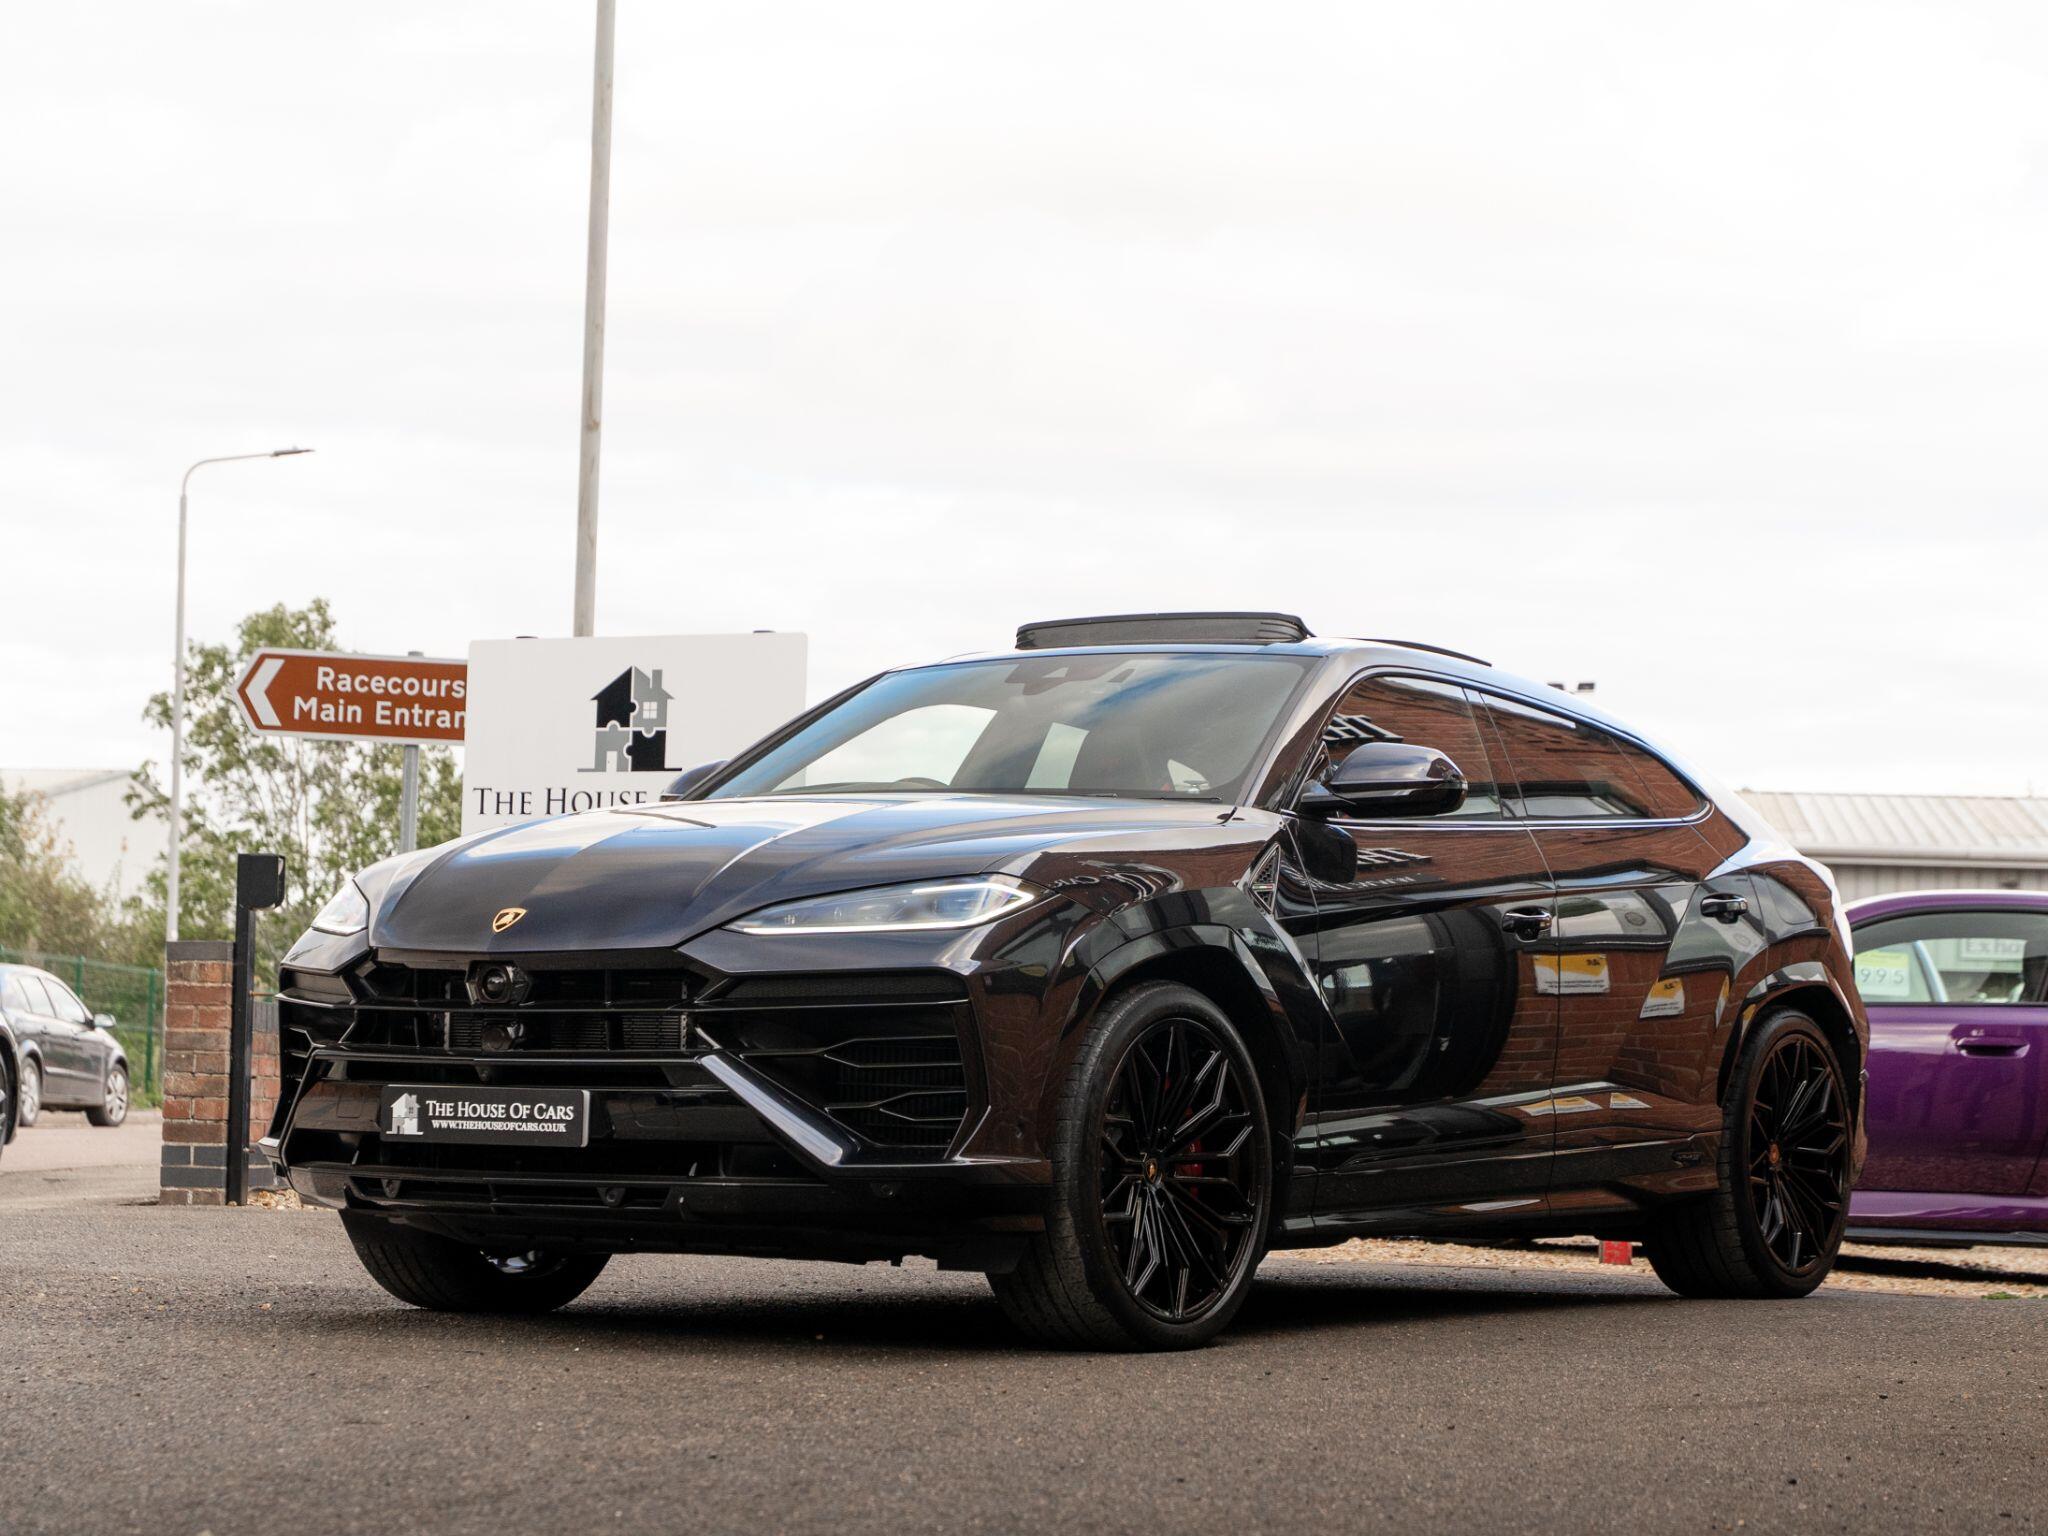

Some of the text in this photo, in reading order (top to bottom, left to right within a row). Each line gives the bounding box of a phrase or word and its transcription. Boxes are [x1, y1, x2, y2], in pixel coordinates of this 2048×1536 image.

[316, 665, 466, 699] Racecours
[293, 695, 466, 729] Main Entran
[472, 787, 532, 815] THE
[426, 1100, 574, 1120] THE HOUSE OF CARS
